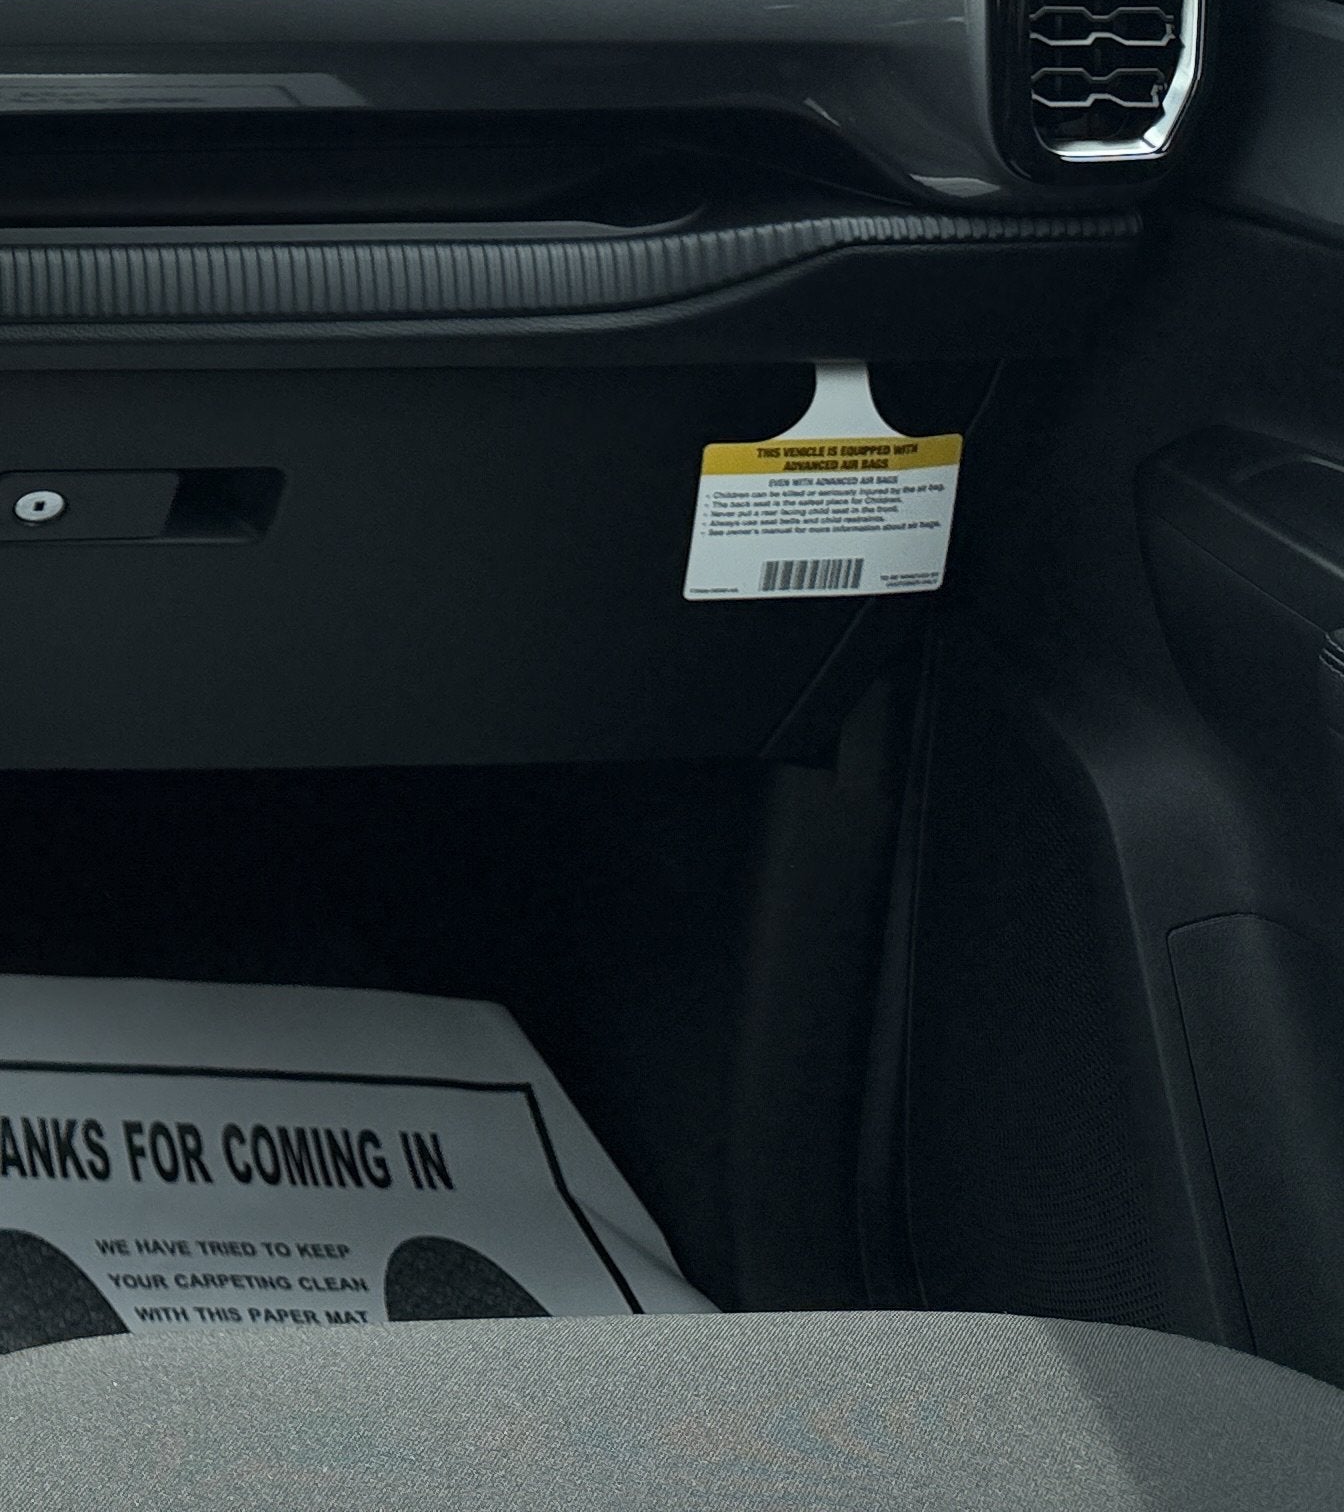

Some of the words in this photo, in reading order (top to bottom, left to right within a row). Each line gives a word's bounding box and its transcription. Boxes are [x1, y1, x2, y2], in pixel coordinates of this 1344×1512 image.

[123, 1121, 212, 1185] FOR
[223, 1123, 393, 1190] COMING
[404, 1130, 454, 1190] IN
[95, 1239, 130, 1257] WE
[135, 1239, 191, 1258] HAVE
[195, 1240, 257, 1259] TRIED
[261, 1241, 291, 1259] TO
[298, 1242, 351, 1260] KEEP
[108, 1272, 169, 1291] YOUR
[174, 1273, 292, 1292] CARPETING
[298, 1274, 369, 1293] CLEAN
[135, 1305, 188, 1323] WITH
[193, 1305, 244, 1324] THIS
[248, 1306, 318, 1325] PAPER
[322, 1308, 369, 1325] MAT
